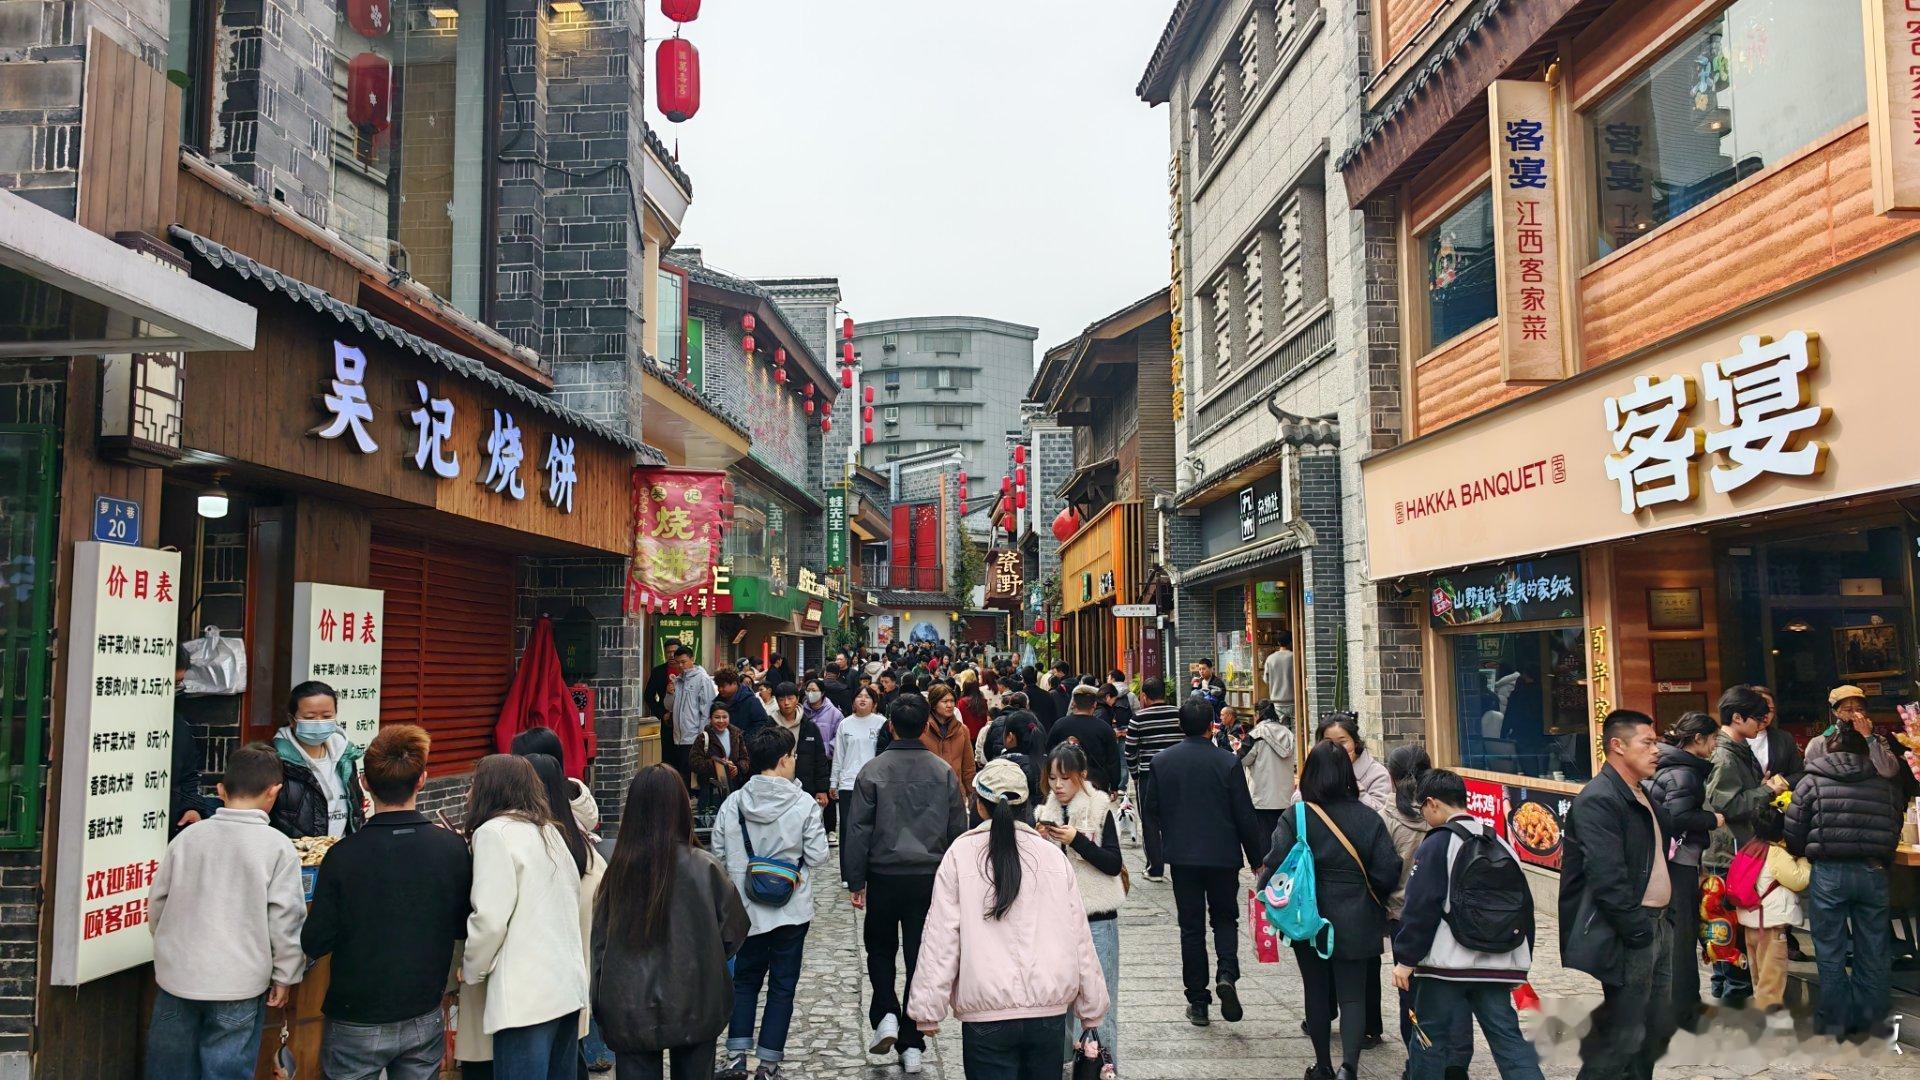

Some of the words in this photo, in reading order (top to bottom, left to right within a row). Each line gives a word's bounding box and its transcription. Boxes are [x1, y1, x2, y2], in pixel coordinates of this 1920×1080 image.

[1505, 119, 1547, 190] 客宴
[1516, 200, 1547, 341] 江西客家菜
[318, 340, 578, 514] 吴记烧饼
[1603, 329, 1822, 515] 客宴
[1406, 488, 1457, 520] HAKKA
[1460, 460, 1547, 506] BANQUET
[99, 501, 135, 519] 萝卜巷
[108, 518, 126, 538] 20
[106, 565, 173, 602] 价目表
[997, 551, 1023, 596] 瓷野
[1453, 585, 1497, 609] 山野真味
[318, 608, 376, 644] 价目表
[97, 634, 140, 654] 梅干菜小饼
[143, 637, 173, 658] 2.5元/个
[313, 663, 349, 676] 梅干菜小饼
[351, 664, 377, 676] 2.5元/个
[96, 676, 138, 696] 香葱肉小饼
[141, 677, 172, 698] 2.5元/个
[351, 688, 376, 700] 2.5元/个
[356, 719, 376, 732] 8元/个
[93, 731, 135, 753] 梅干菜大饼
[146, 729, 170, 750] 8元/个
[91, 772, 134, 797] 香葱肉大饼
[145, 769, 168, 790] 8元/个
[88, 814, 123, 840] 香甜大饼
[142, 809, 166, 830] 5元/个
